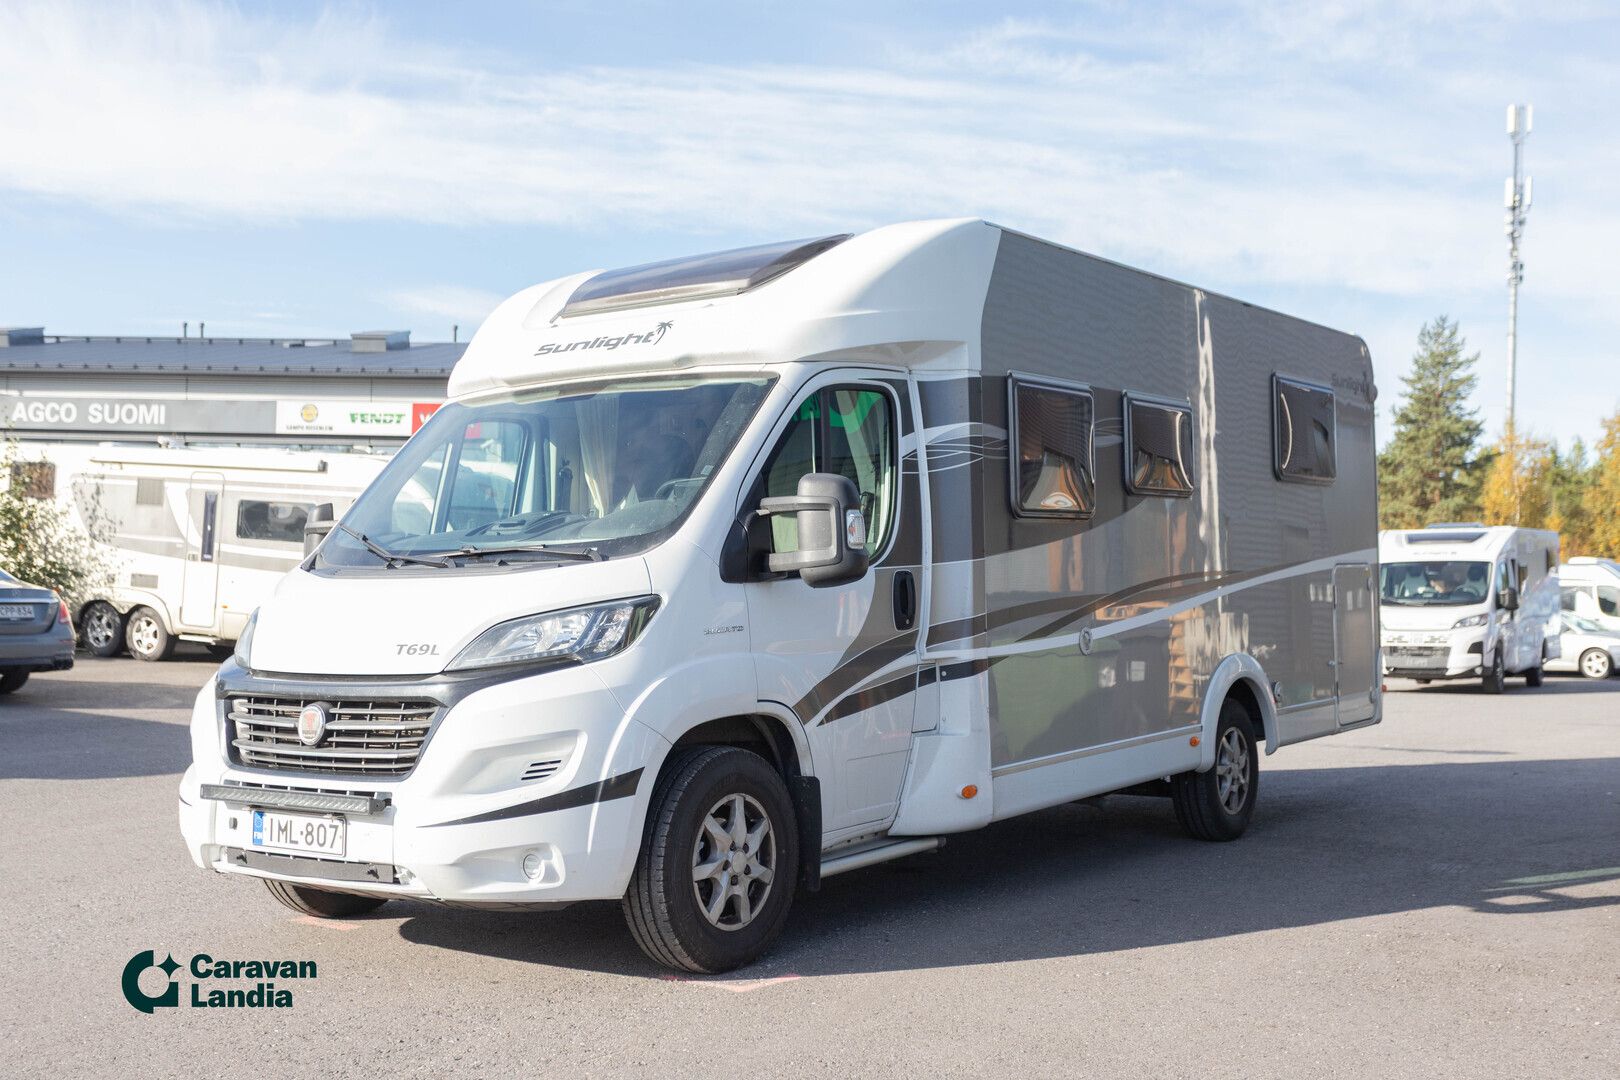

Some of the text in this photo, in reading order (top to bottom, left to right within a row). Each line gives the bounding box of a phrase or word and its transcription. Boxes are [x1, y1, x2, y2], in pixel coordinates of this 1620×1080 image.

[534, 331, 655, 357] Sunlight
[12, 401, 166, 425] AGCO SUOMI
[349, 412, 406, 424] FENDT
[396, 643, 440, 656] T69L
[269, 817, 340, 849] IML-807
